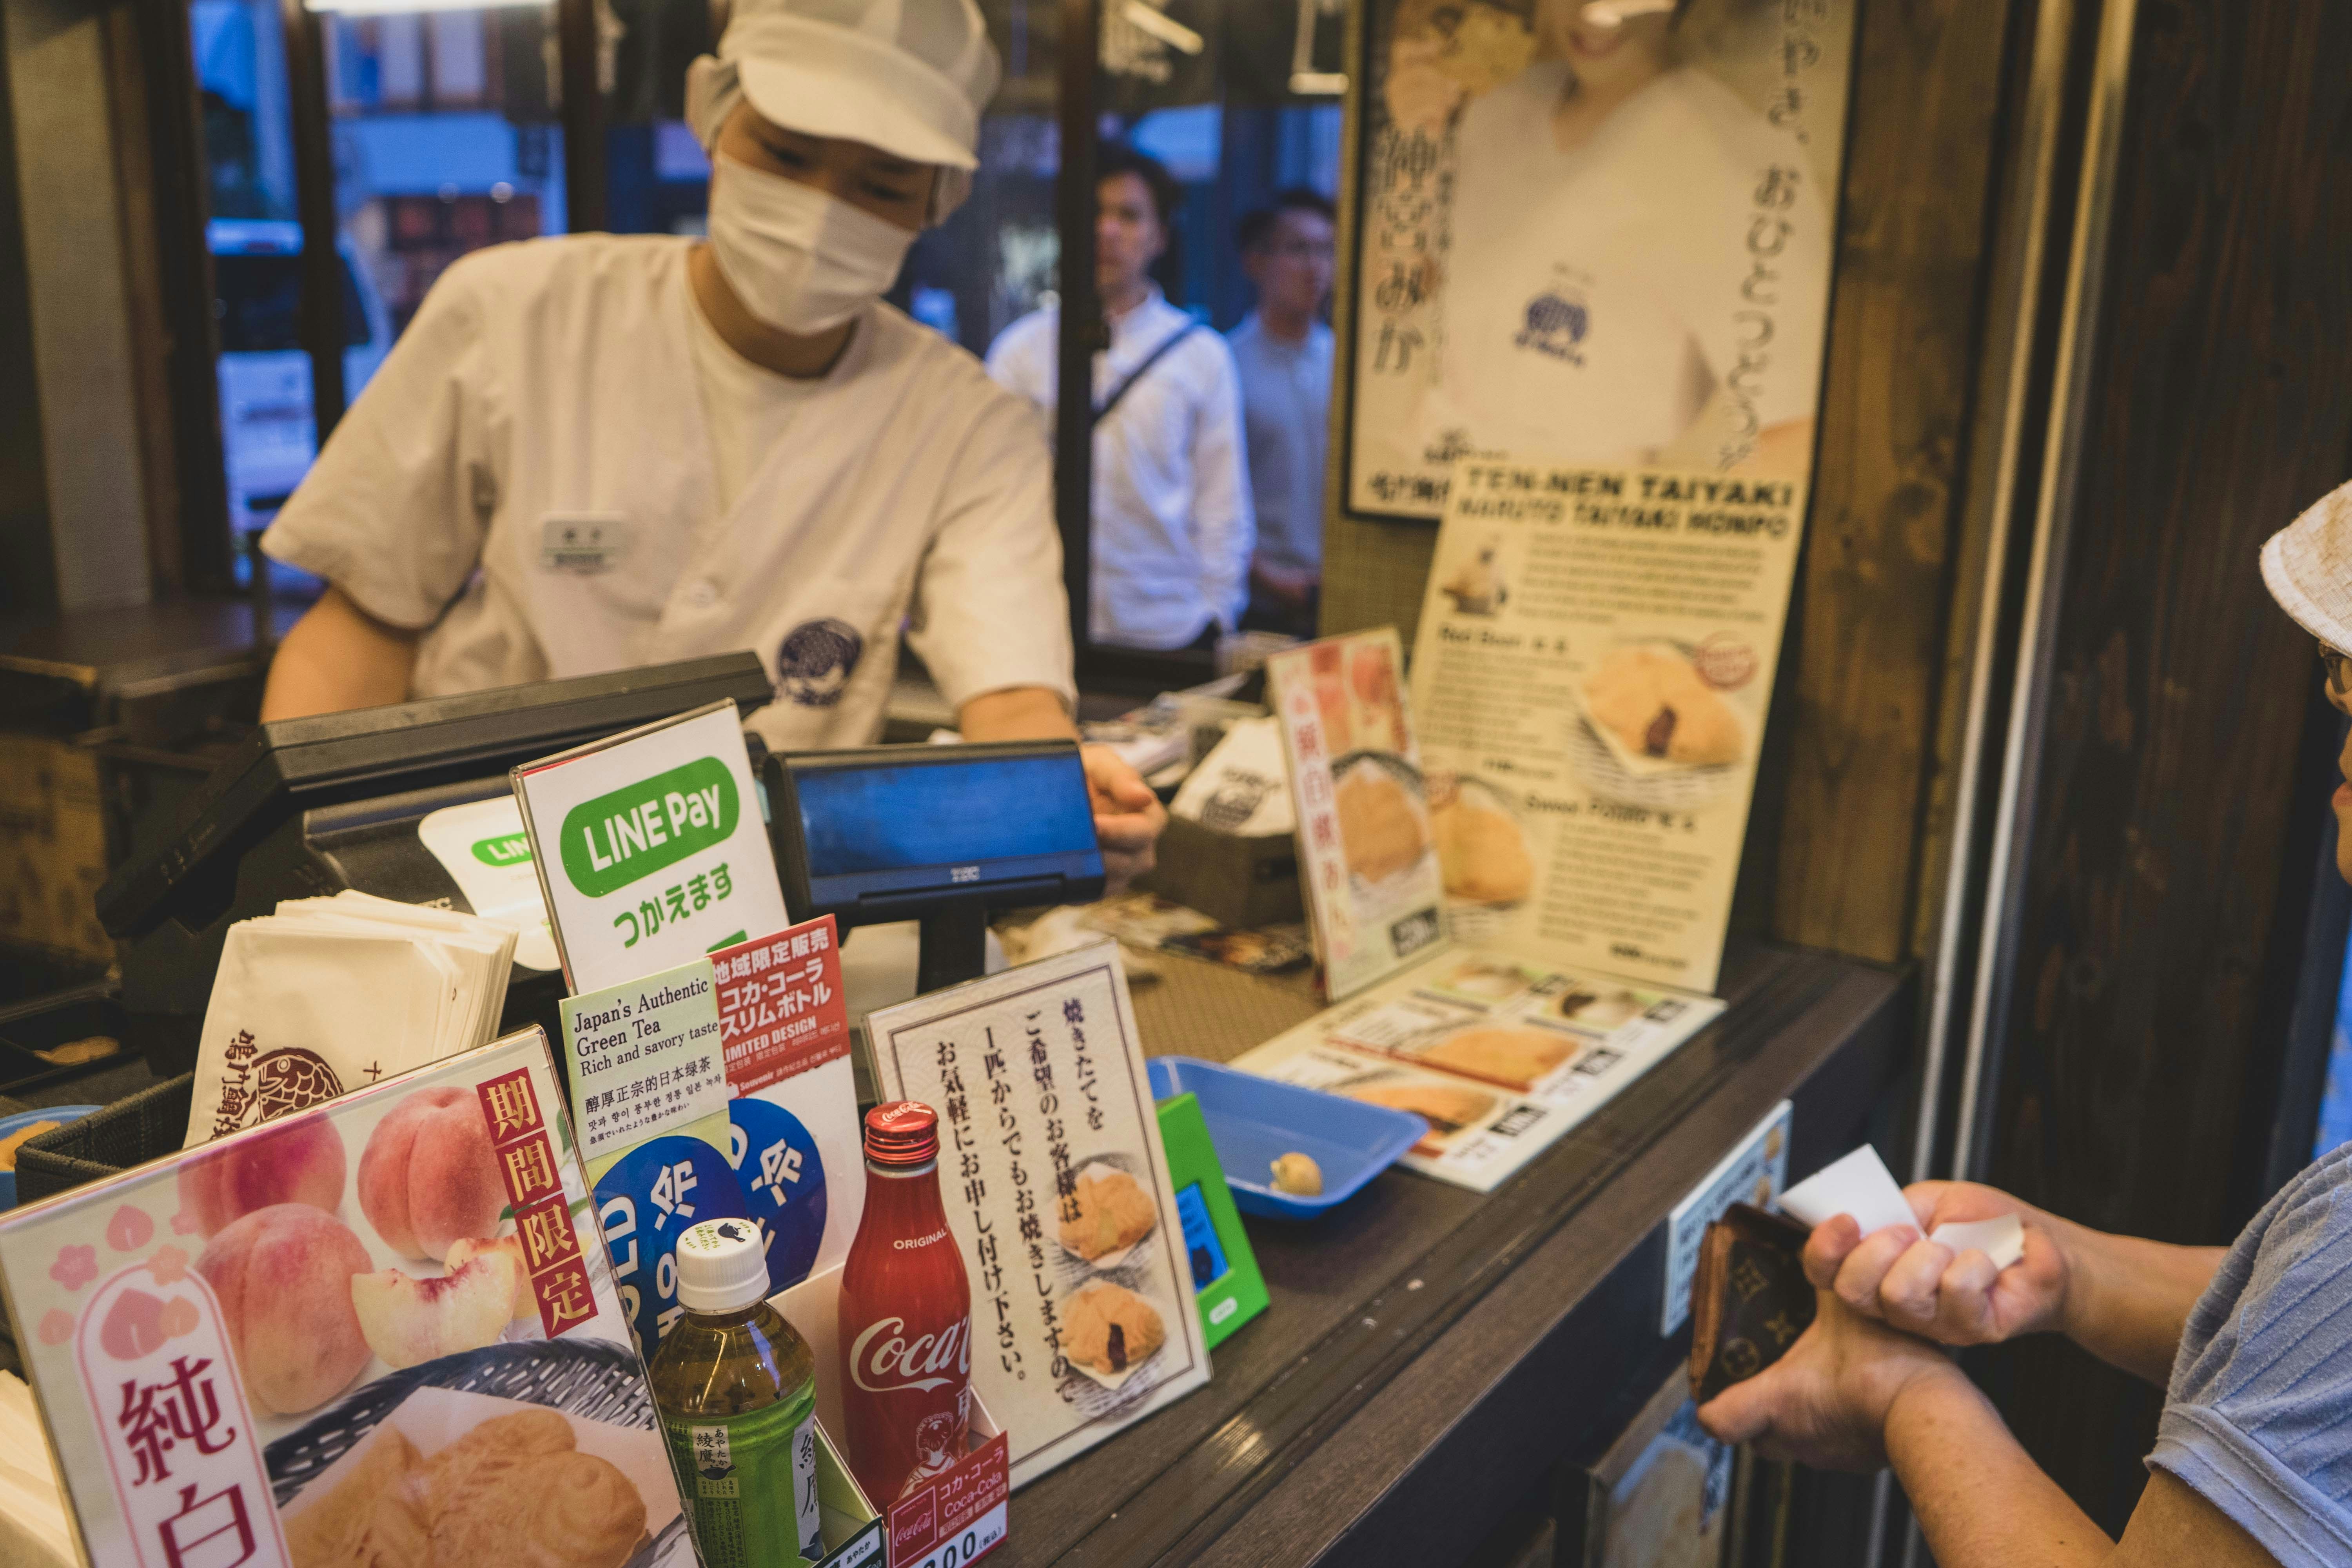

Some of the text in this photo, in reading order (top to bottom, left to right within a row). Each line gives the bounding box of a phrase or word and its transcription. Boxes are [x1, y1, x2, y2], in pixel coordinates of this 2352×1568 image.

[1639, 476, 1795, 506] TAIYAKI
[583, 783, 720, 873] LINE Pay
[613, 862, 732, 949] つかえます
[713, 927, 829, 985] 地域限定販売
[574, 978, 709, 1033] Japan's Authentic
[720, 981, 832, 1042] スリムボトル
[721, 956, 824, 1014] コカ・コーラ
[577, 1018, 661, 1057] Green Tea
[580, 1022, 719, 1077] Rich and savory taste
[725, 1015, 817, 1063] IMITED DESIGN
[1062, 997, 1104, 1131] 焼きたてを
[585, 1055, 711, 1115] 醇厚正宗的日本绿茶
[588, 1073, 722, 1132] 맛과 향이 풍부한 정통 일본 녹차
[740, 1071, 775, 1091] Souvenir
[589, 1102, 690, 1145] 急須でいれたような豊かな味わい
[882, 1101, 924, 1123] Coca-Cola
[1024, 1010, 1083, 1224] ご希望のお客様は
[650, 1160, 698, 1231] 冷
[750, 1138, 803, 1207] 冷
[486, 1075, 591, 1332] 期間限定
[936, 1041, 1025, 1381] お気軽にお申し付け下さい。
[984, 1026, 1074, 1403] 1匹からでもお焼きしますので
[893, 1227, 948, 1250] ORIGINAL
[118, 1354, 257, 1568] 純白
[697, 1432, 715, 1464] 綾鷹
[715, 1428, 728, 1466] あやたか
[940, 1445, 1004, 1501] コカ・コーラ
[944, 1472, 1003, 1518] Coca-Cola
[846, 1541, 871, 1564] あやたか
[895, 1509, 934, 1547] Coca-Cola
